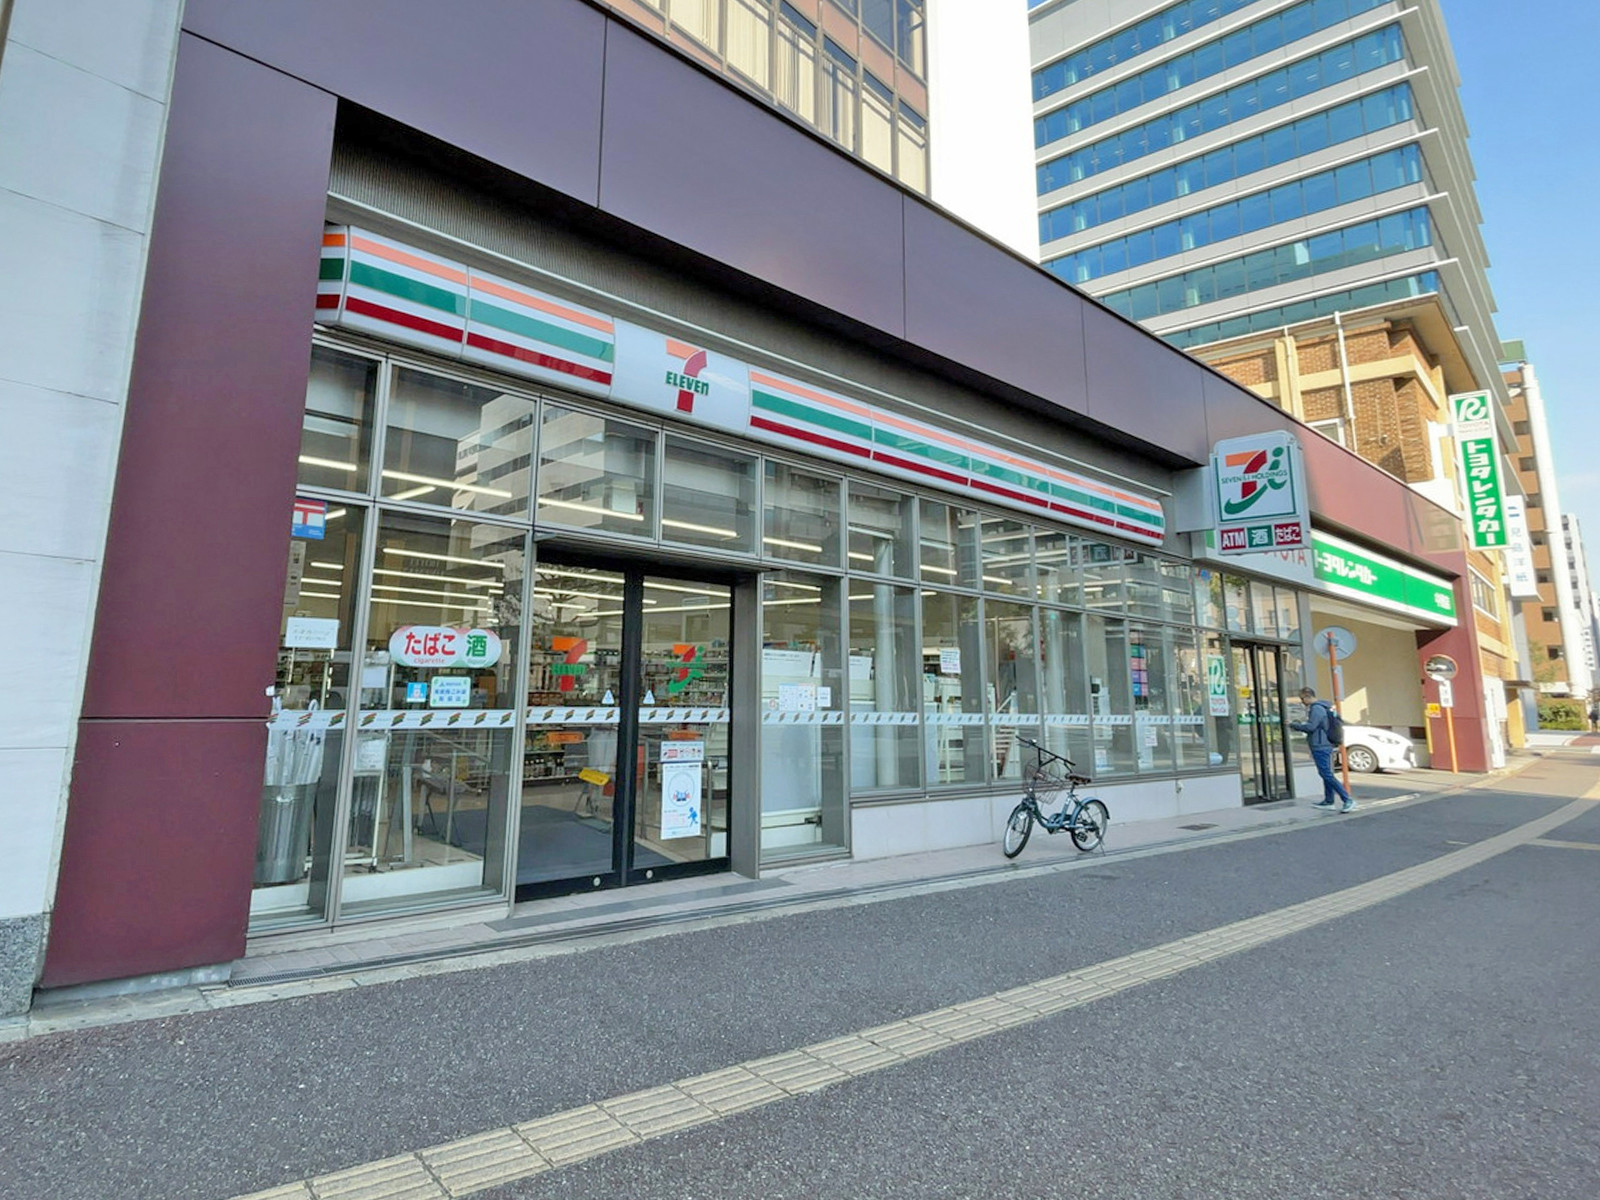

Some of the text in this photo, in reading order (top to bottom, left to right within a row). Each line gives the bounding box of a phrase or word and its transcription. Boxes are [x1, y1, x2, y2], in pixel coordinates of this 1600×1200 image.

[1466, 441, 1501, 545] トヨタレンタカー
[1222, 532, 1246, 549] ATM
[1252, 529, 1269, 546] 酒
[1275, 526, 1301, 543] たばこ
[404, 632, 487, 657] たばこ 酒
